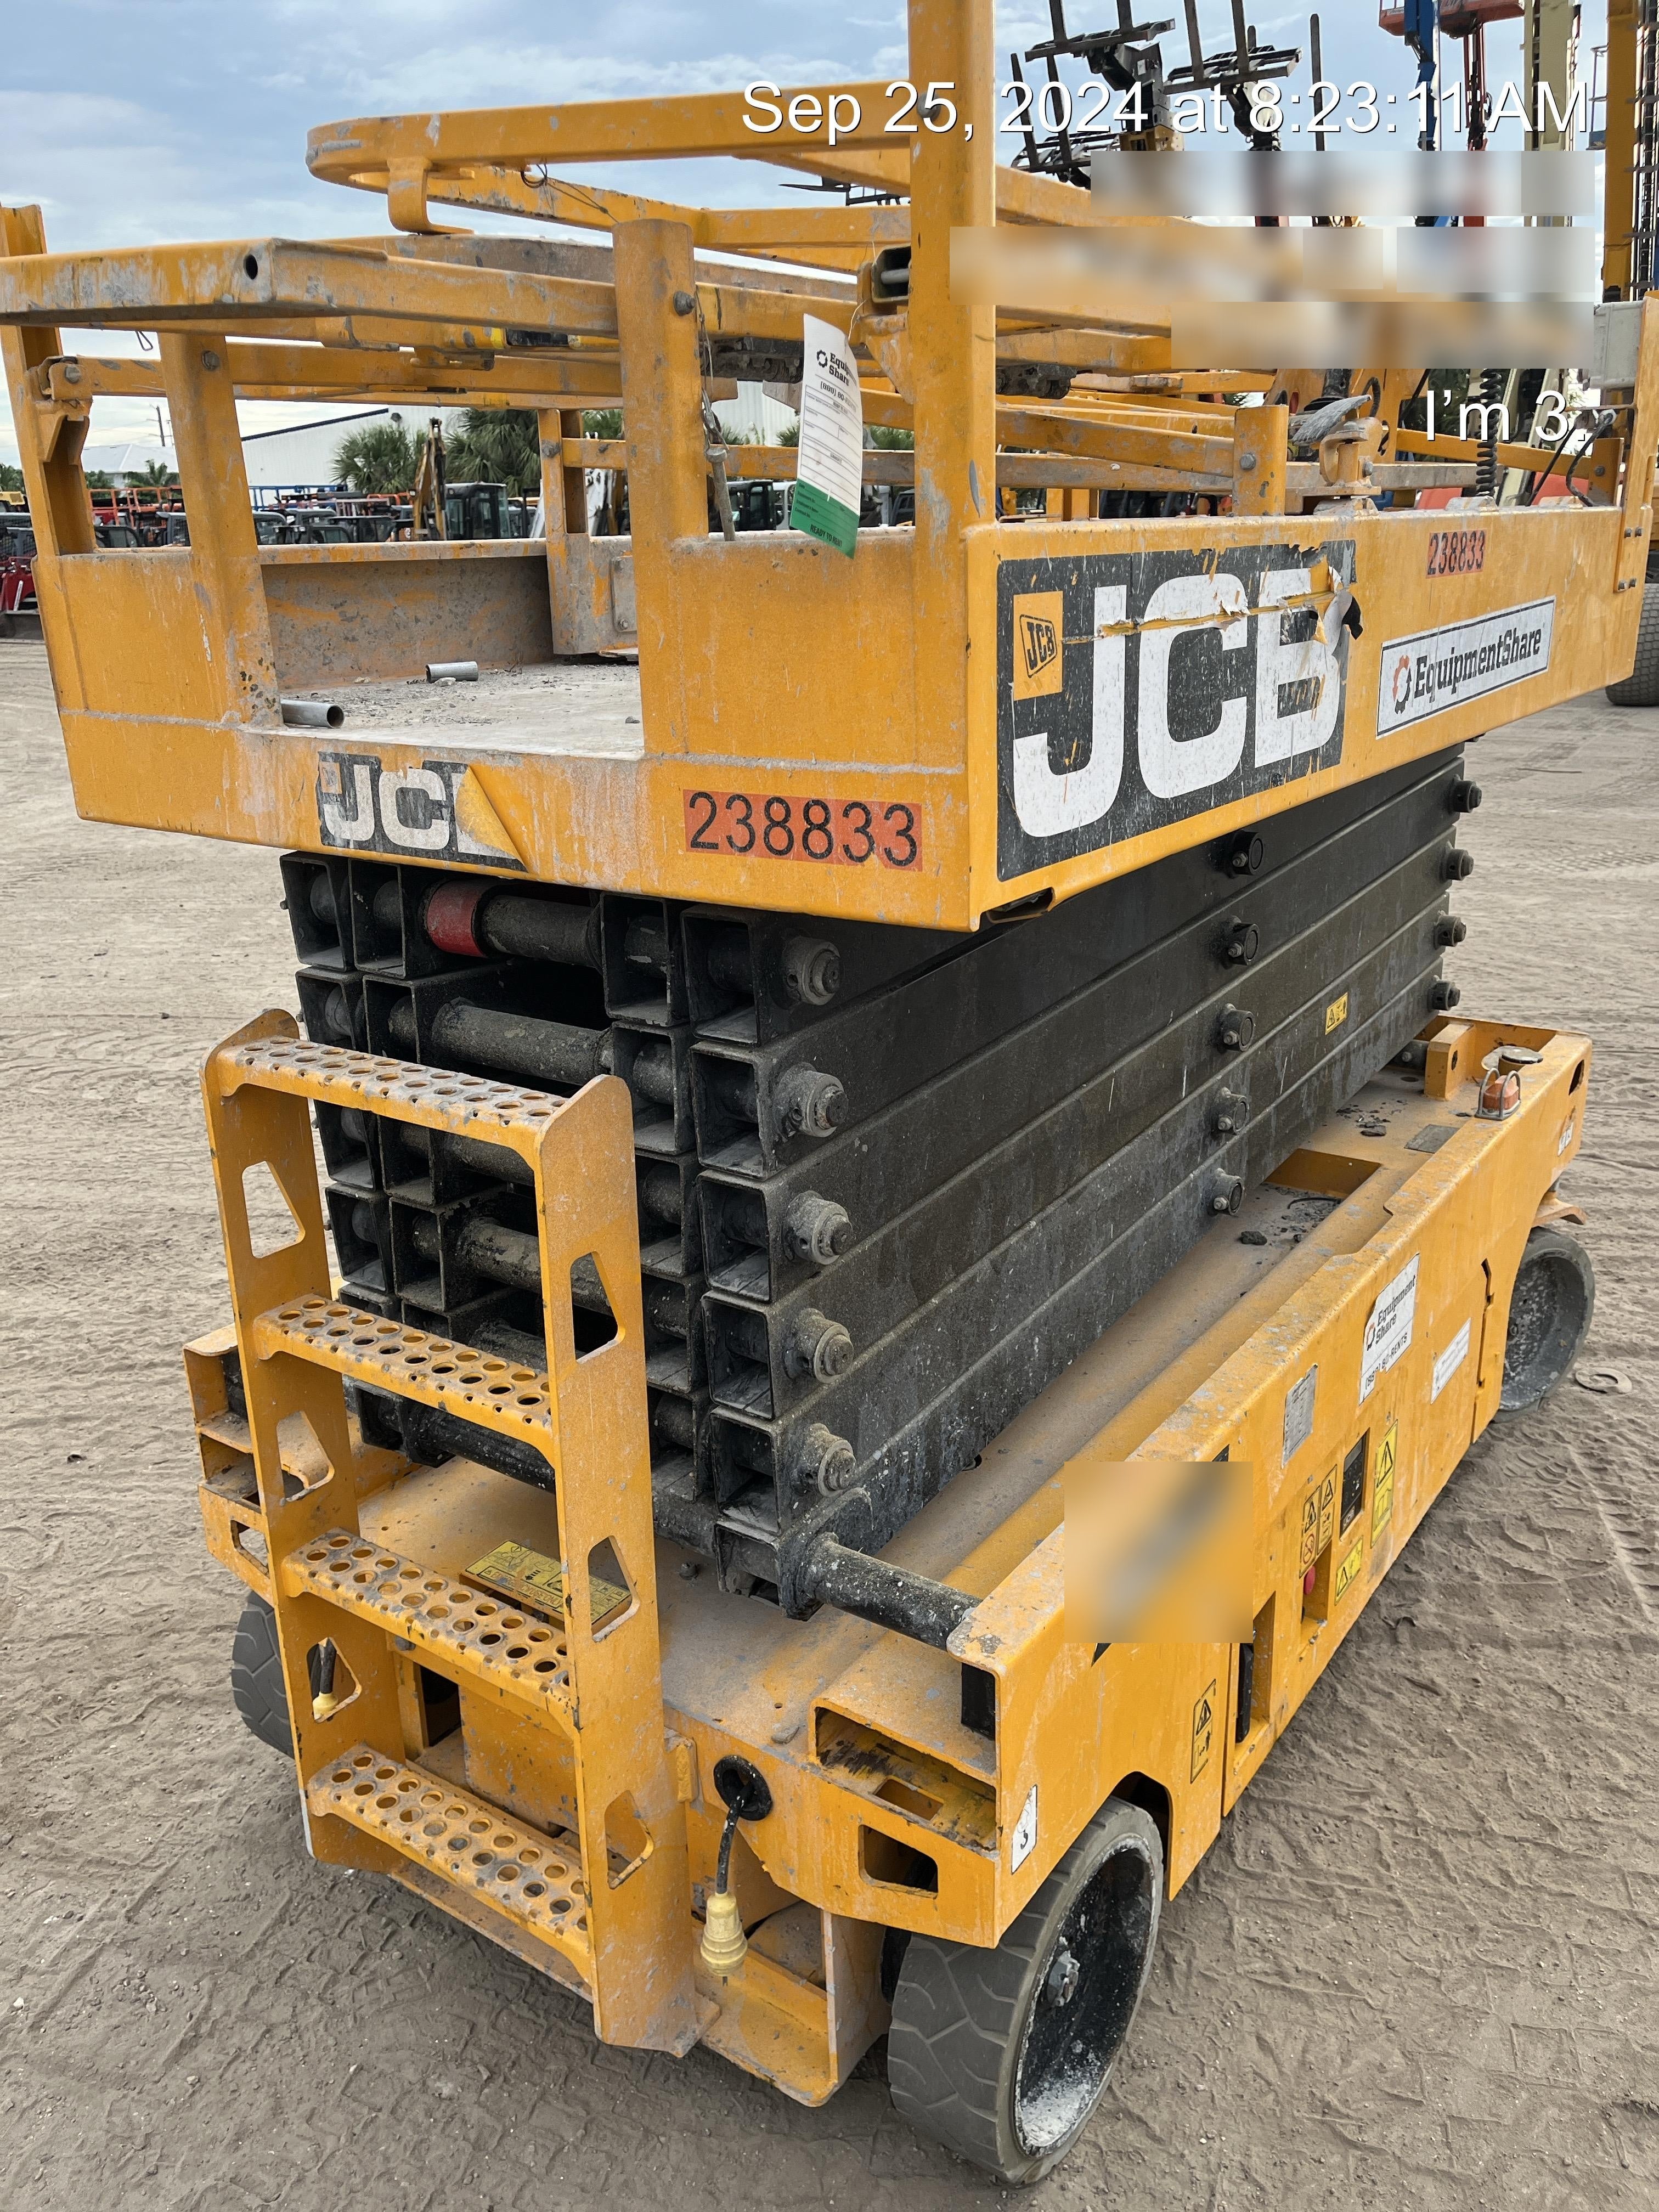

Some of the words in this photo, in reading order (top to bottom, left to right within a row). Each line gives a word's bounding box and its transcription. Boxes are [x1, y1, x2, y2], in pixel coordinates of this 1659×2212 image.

[1427, 530, 1485, 575] 238833
[1026, 621, 1054, 670] JCB
[1413, 627, 1542, 703] EquipmentShare
[1013, 567, 1342, 838] JCB
[689, 792, 917, 867] 238833
[1377, 1274, 1416, 1327] Equipment
[1375, 1313, 1397, 1345] Share
